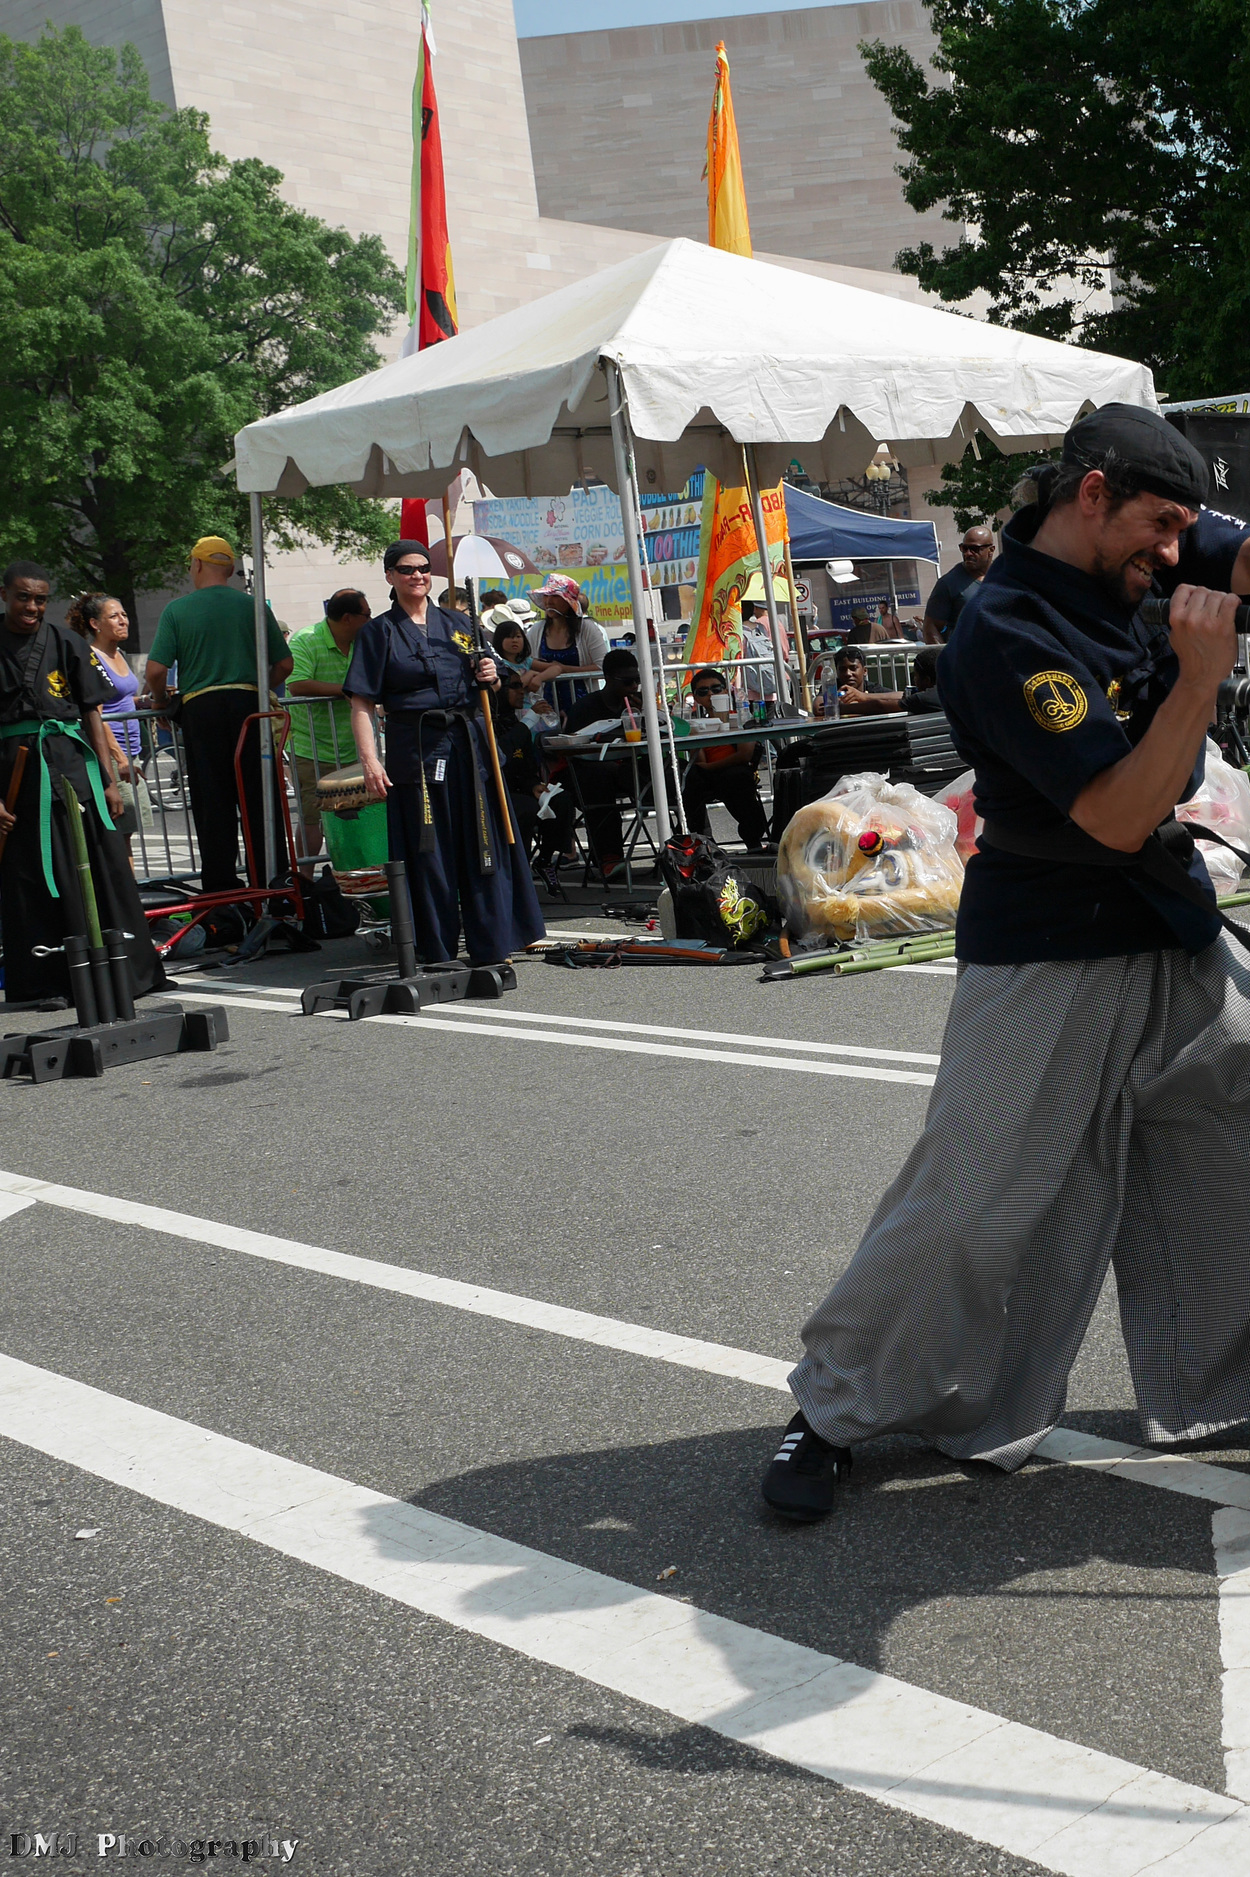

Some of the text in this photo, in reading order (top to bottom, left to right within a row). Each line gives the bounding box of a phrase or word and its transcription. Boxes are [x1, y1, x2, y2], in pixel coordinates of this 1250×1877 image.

[572, 489, 598, 507] PAD
[509, 512, 540, 528] NOODLE
[574, 506, 604, 523] VEGGIE
[522, 530, 539, 544] RICE
[574, 525, 600, 541] CORN
[853, 596, 887, 604] BUILDING
[594, 605, 612, 617] Pine
